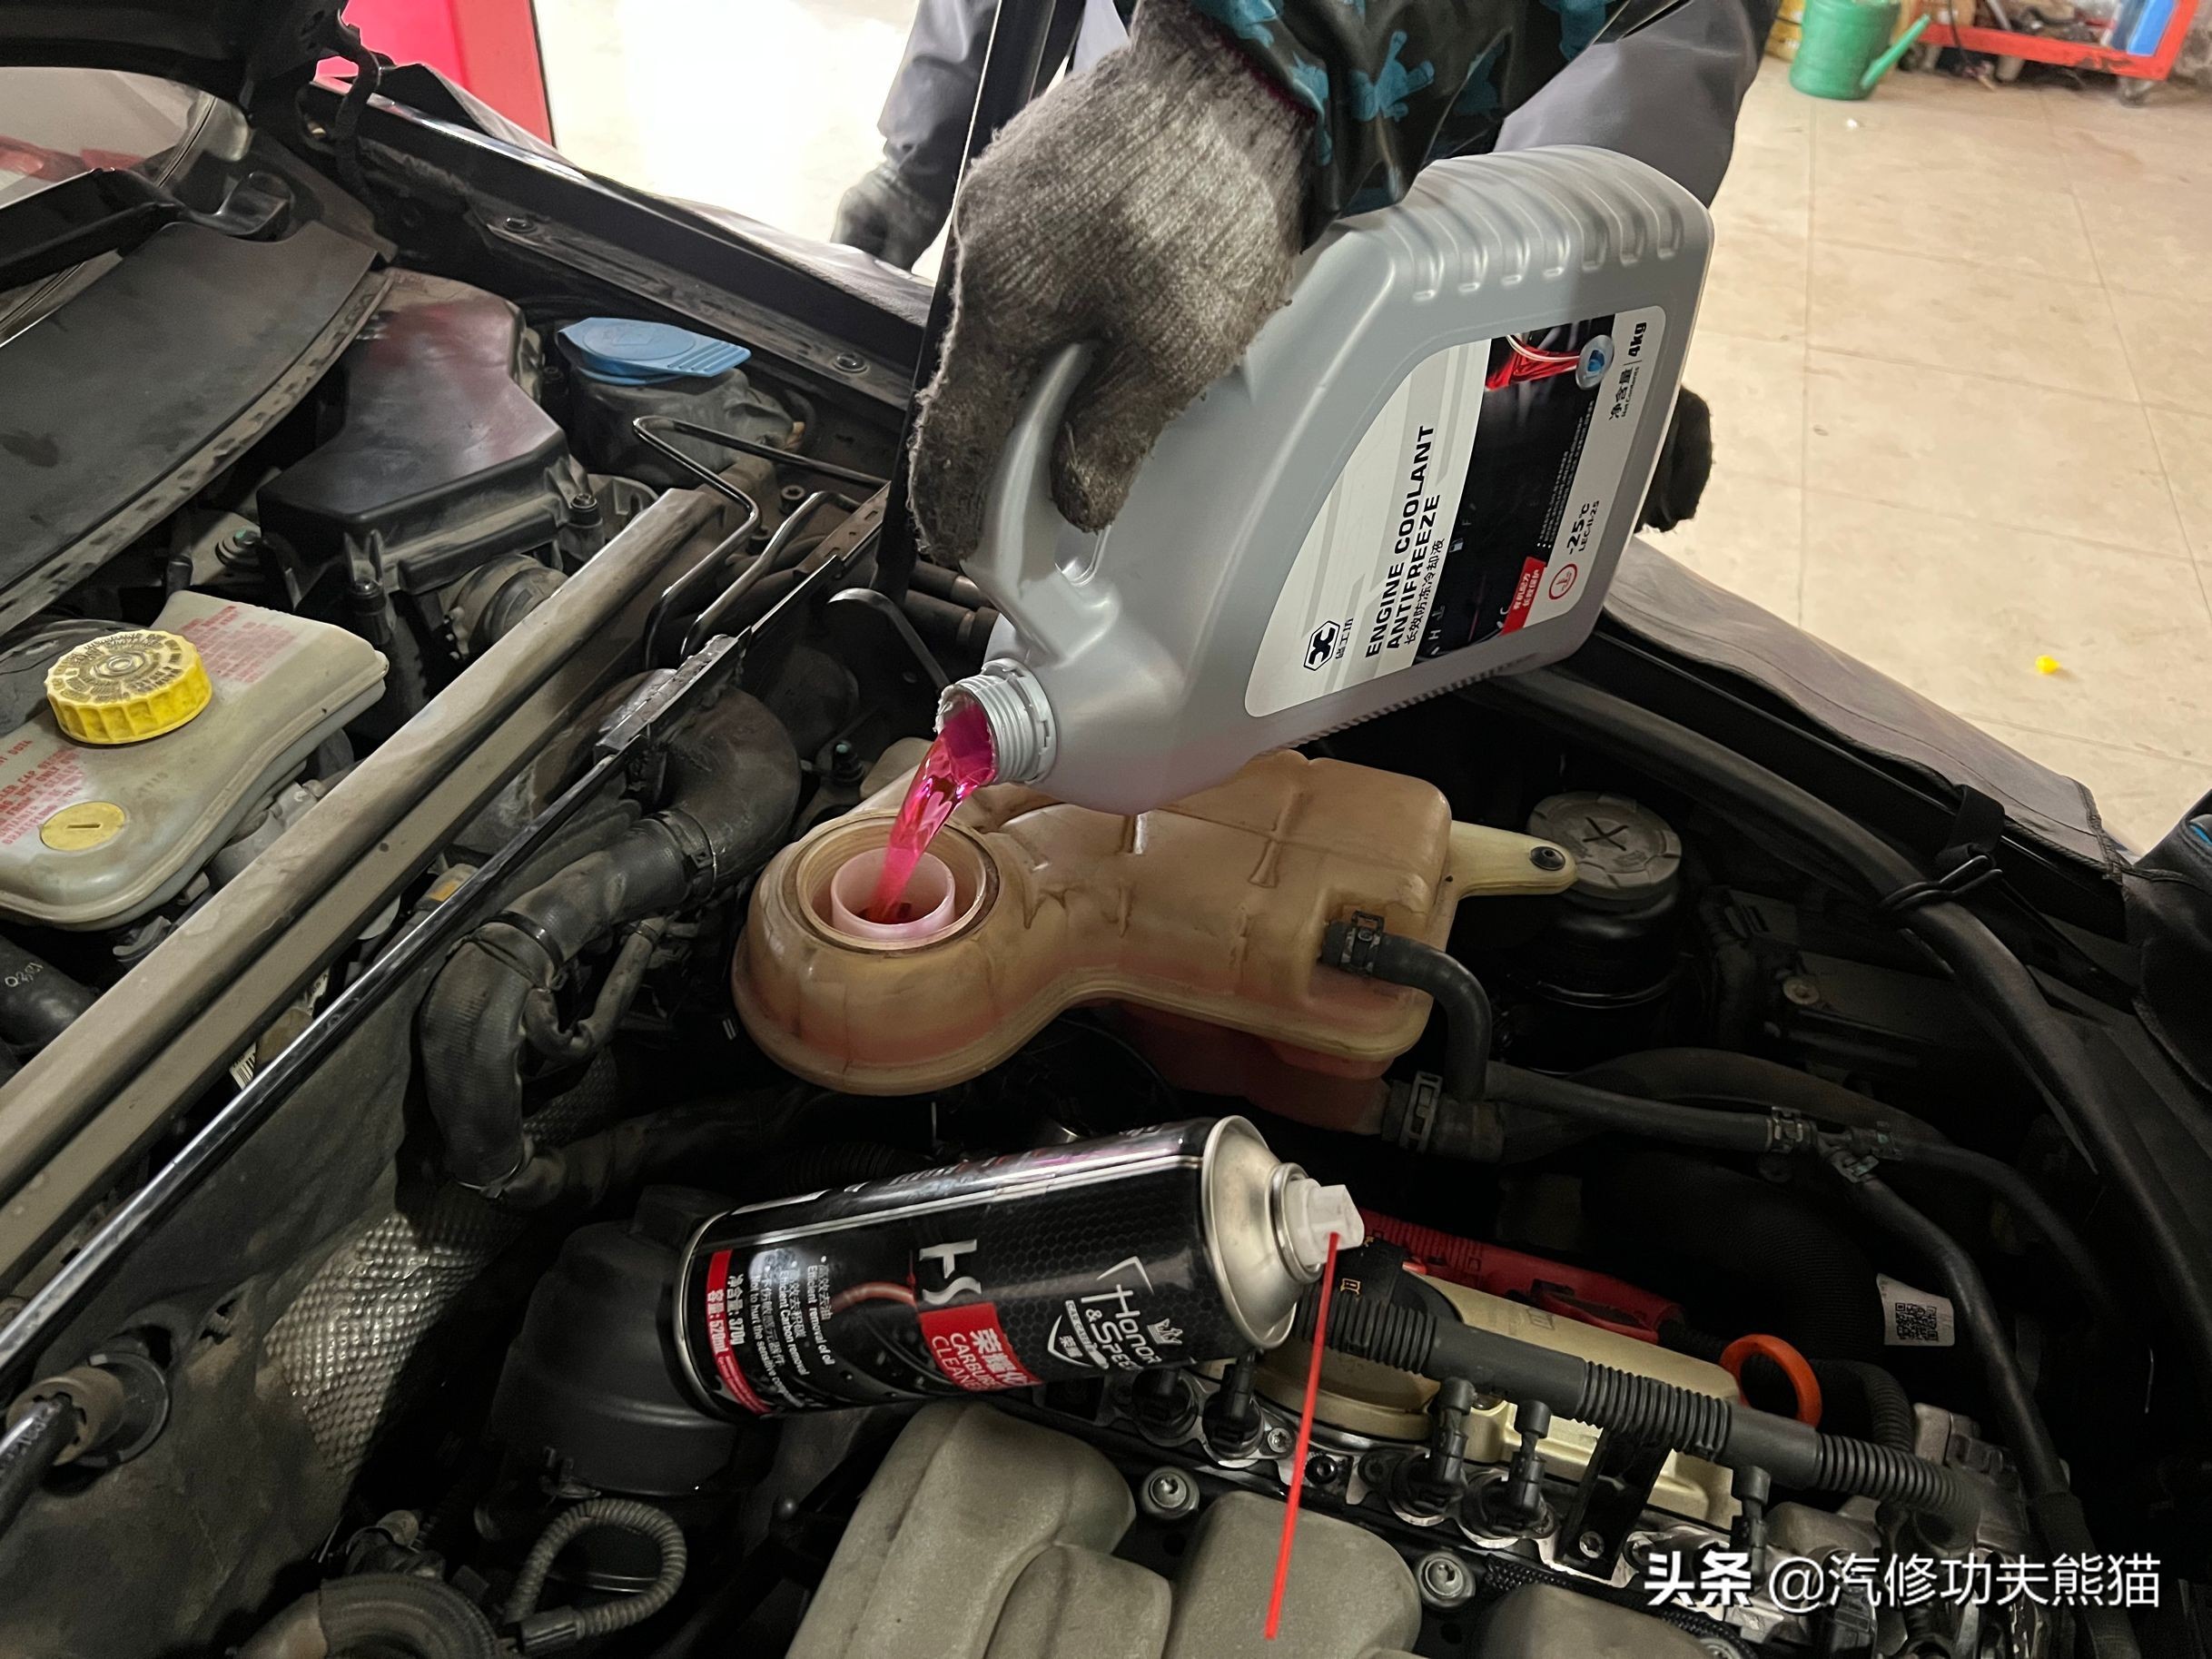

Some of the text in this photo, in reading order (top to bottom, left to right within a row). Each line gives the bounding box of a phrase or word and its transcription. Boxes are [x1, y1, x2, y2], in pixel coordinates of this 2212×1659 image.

[1608, 322, 1647, 420] 净含量 4kg
[1366, 426, 1435, 658] ENGINE COOLANT
[1387, 494, 1441, 649] ANTIFREEZE
[1404, 538, 1446, 645] 长效防冻冷却液
[750, 1293, 759, 1303] to
[807, 1265, 818, 1304] Efficient
[819, 1264, 833, 1320] 高效去油
[751, 1305, 762, 1324] hurt
[753, 1326, 763, 1340] the
[808, 1308, 827, 1344] removal
[1085, 1308, 1102, 1322] &
[756, 1340, 776, 1377] sensitive
[780, 1309, 795, 1343] Carbon
[788, 1343, 810, 1376] removal
[817, 1344, 831, 1355] of
